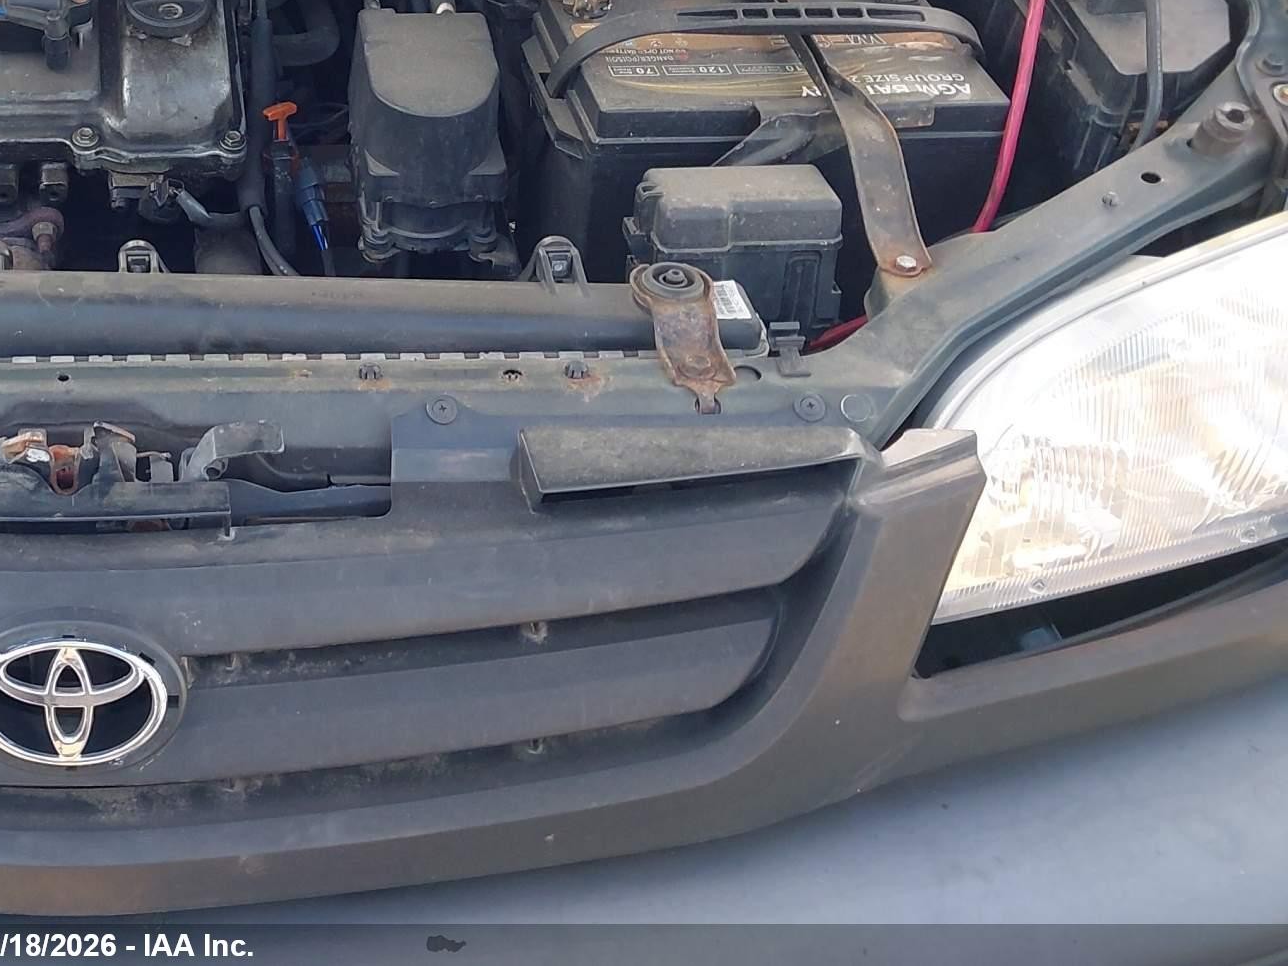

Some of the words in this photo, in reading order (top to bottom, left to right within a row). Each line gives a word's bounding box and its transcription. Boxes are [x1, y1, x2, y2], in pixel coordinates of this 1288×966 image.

[699, 66, 725, 74] 120
[862, 73, 902, 83] SIZE
[903, 73, 965, 83] GROUP
[914, 82, 971, 95] AGM
